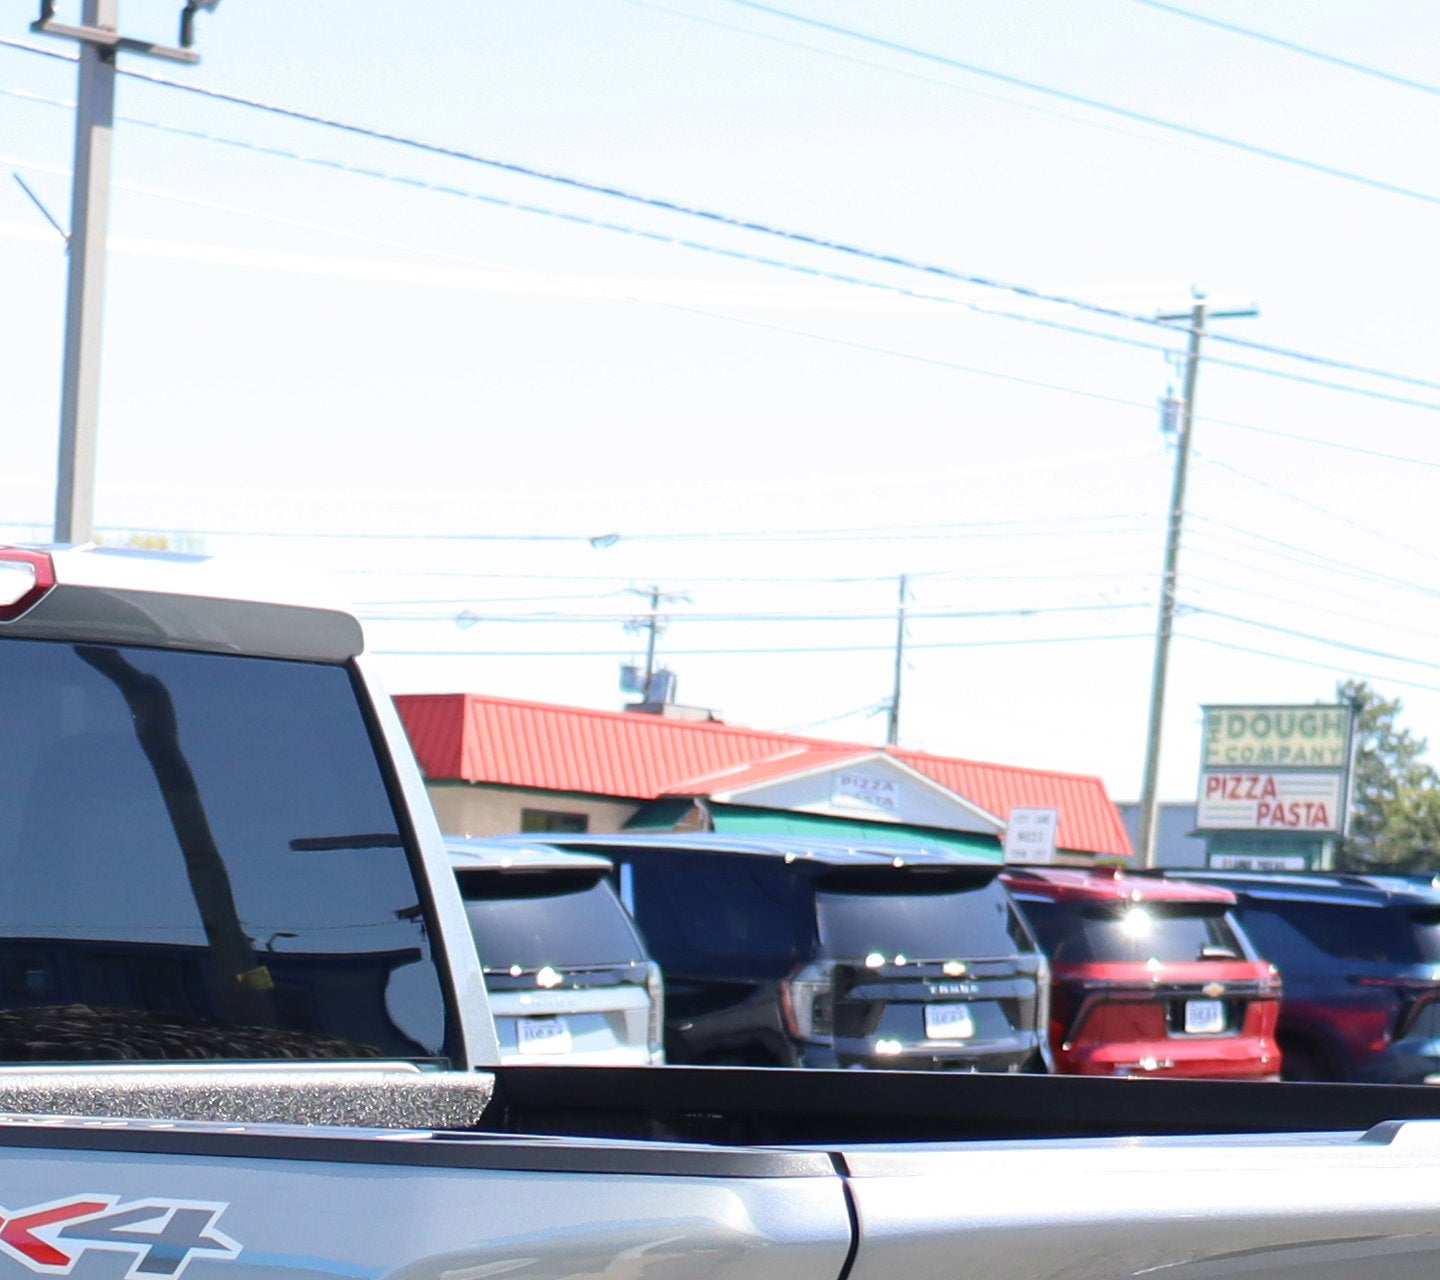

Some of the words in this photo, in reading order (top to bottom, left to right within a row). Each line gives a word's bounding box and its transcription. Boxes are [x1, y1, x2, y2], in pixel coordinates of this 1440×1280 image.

[1227, 712, 1342, 739] DOUGH
[1225, 745, 1341, 764] COMPANY
[1205, 775, 1277, 799] PIZZA
[1256, 801, 1330, 827] PASTA
